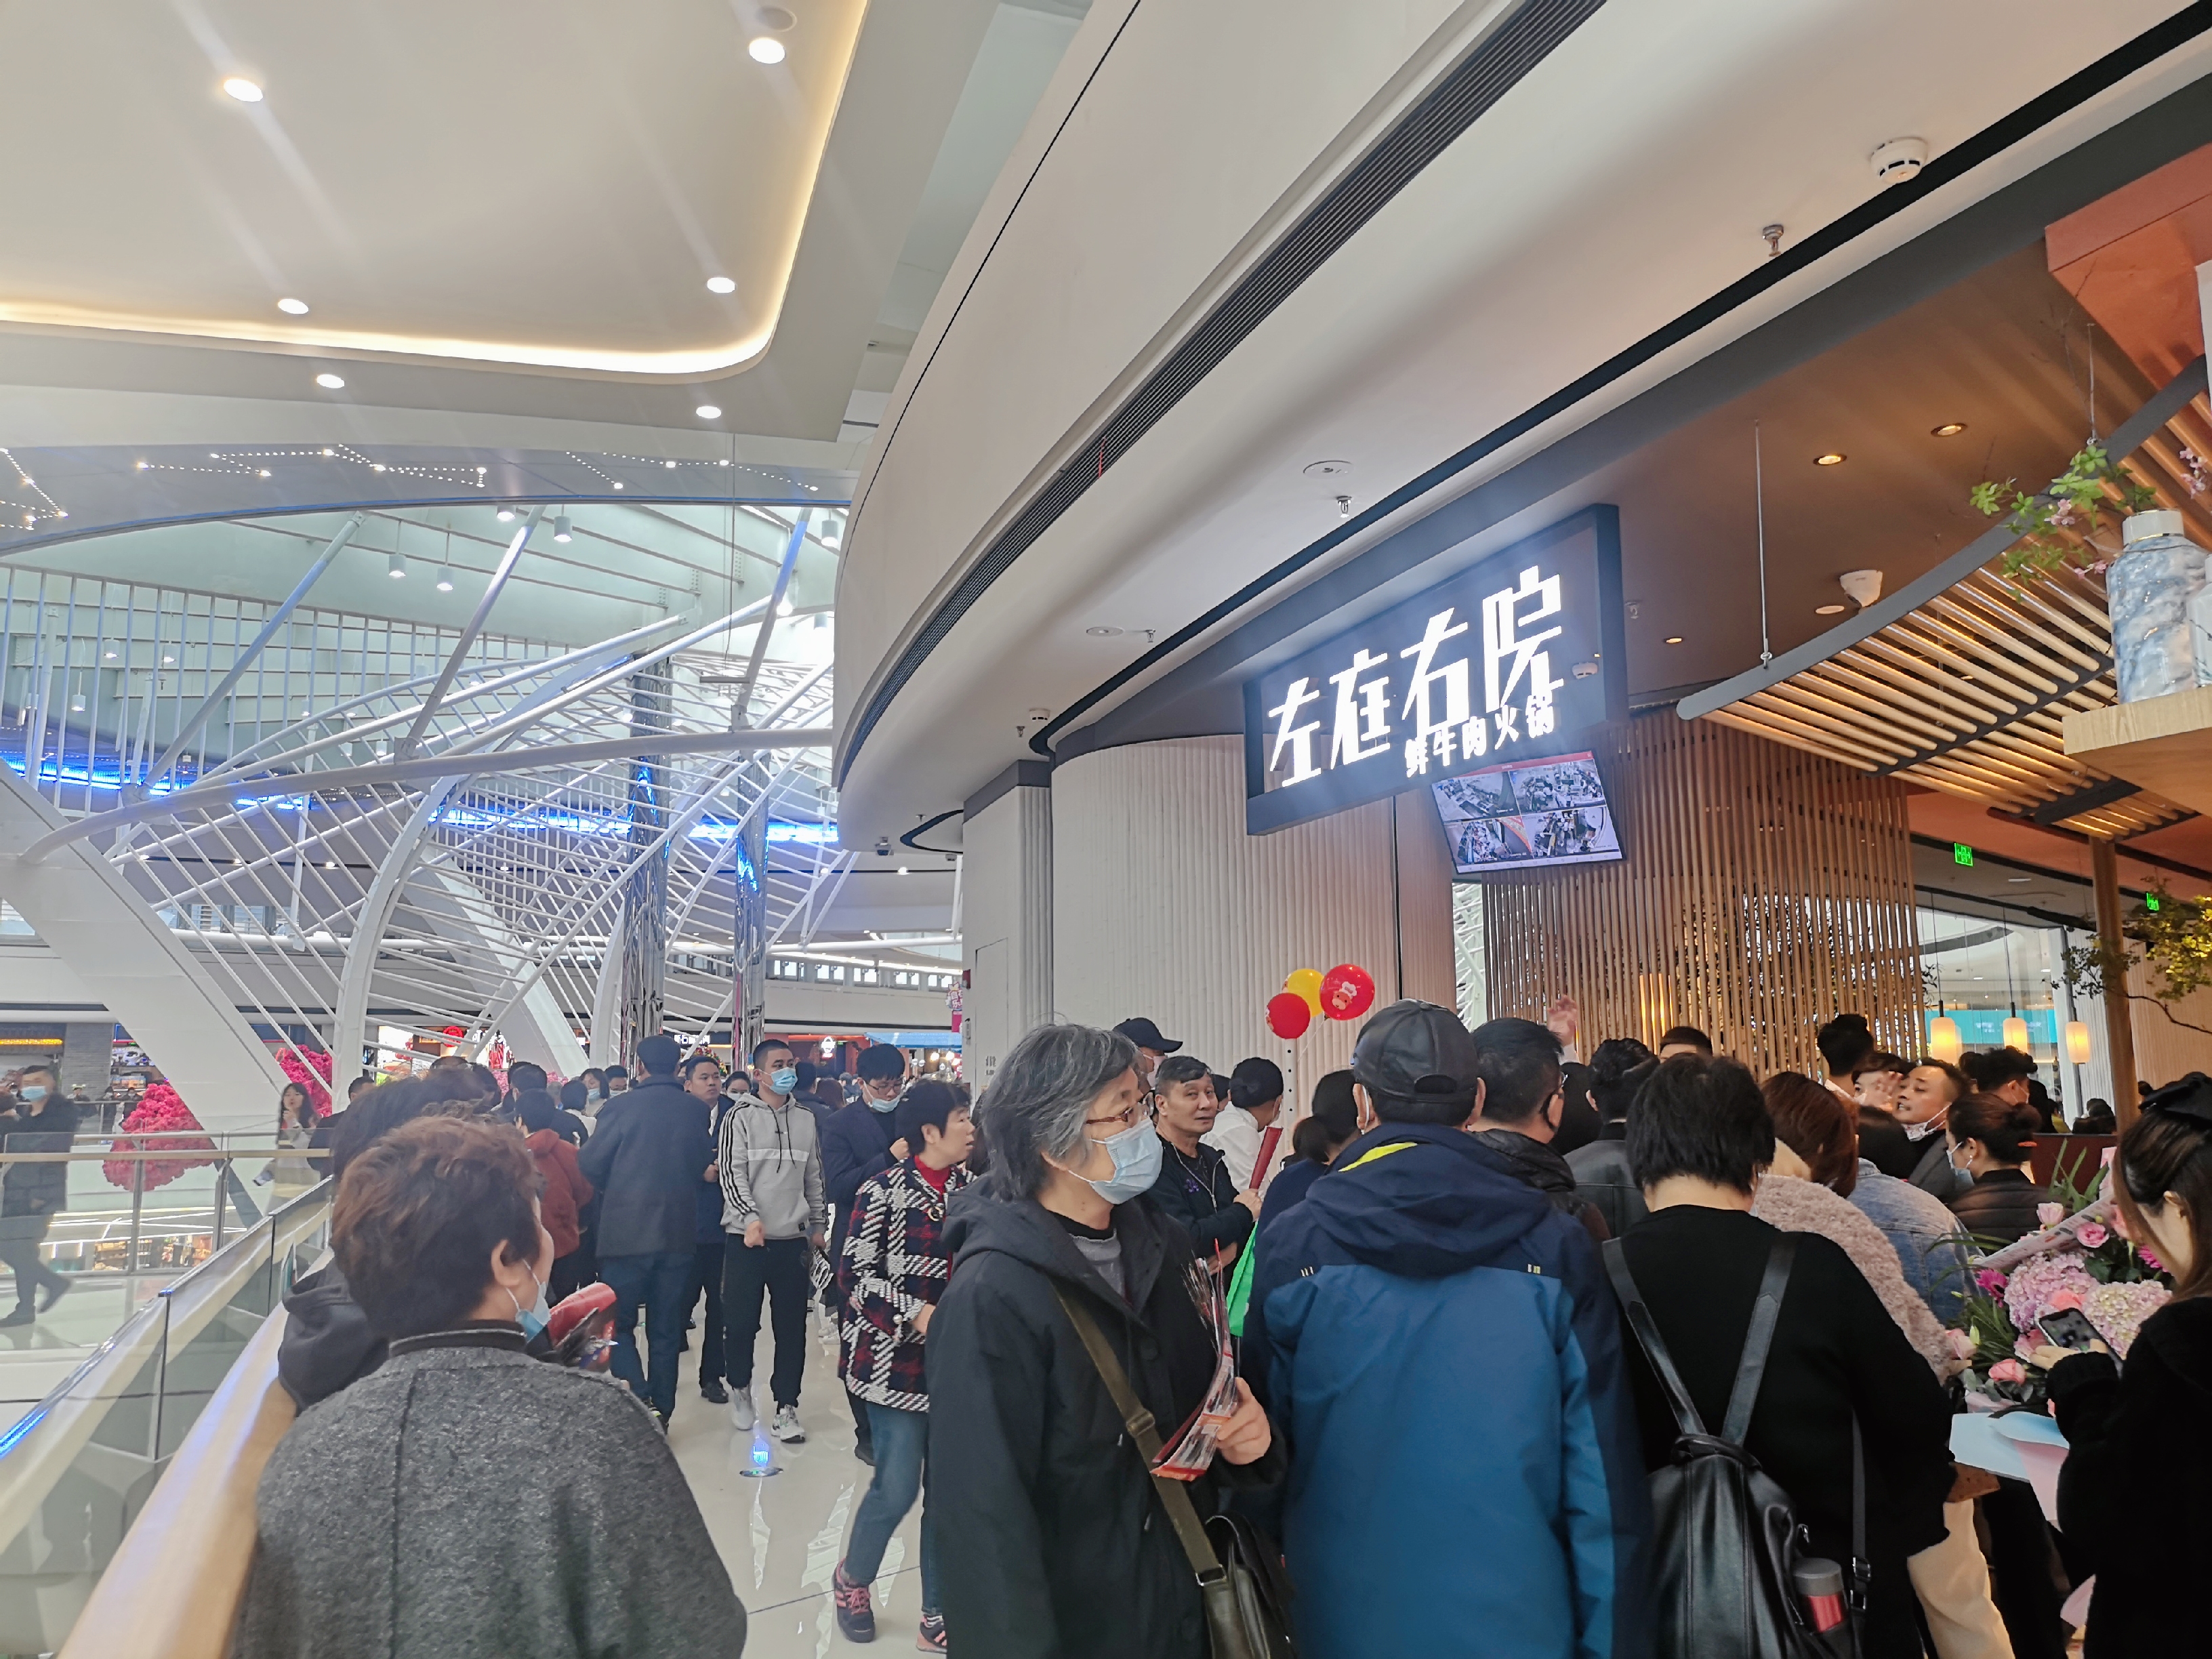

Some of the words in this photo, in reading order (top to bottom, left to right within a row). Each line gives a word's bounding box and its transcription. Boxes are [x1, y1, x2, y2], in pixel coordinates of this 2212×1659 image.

[1268, 565, 1563, 787] 左庭右院
[1405, 695, 1554, 778] 鲜牛肉火锅
